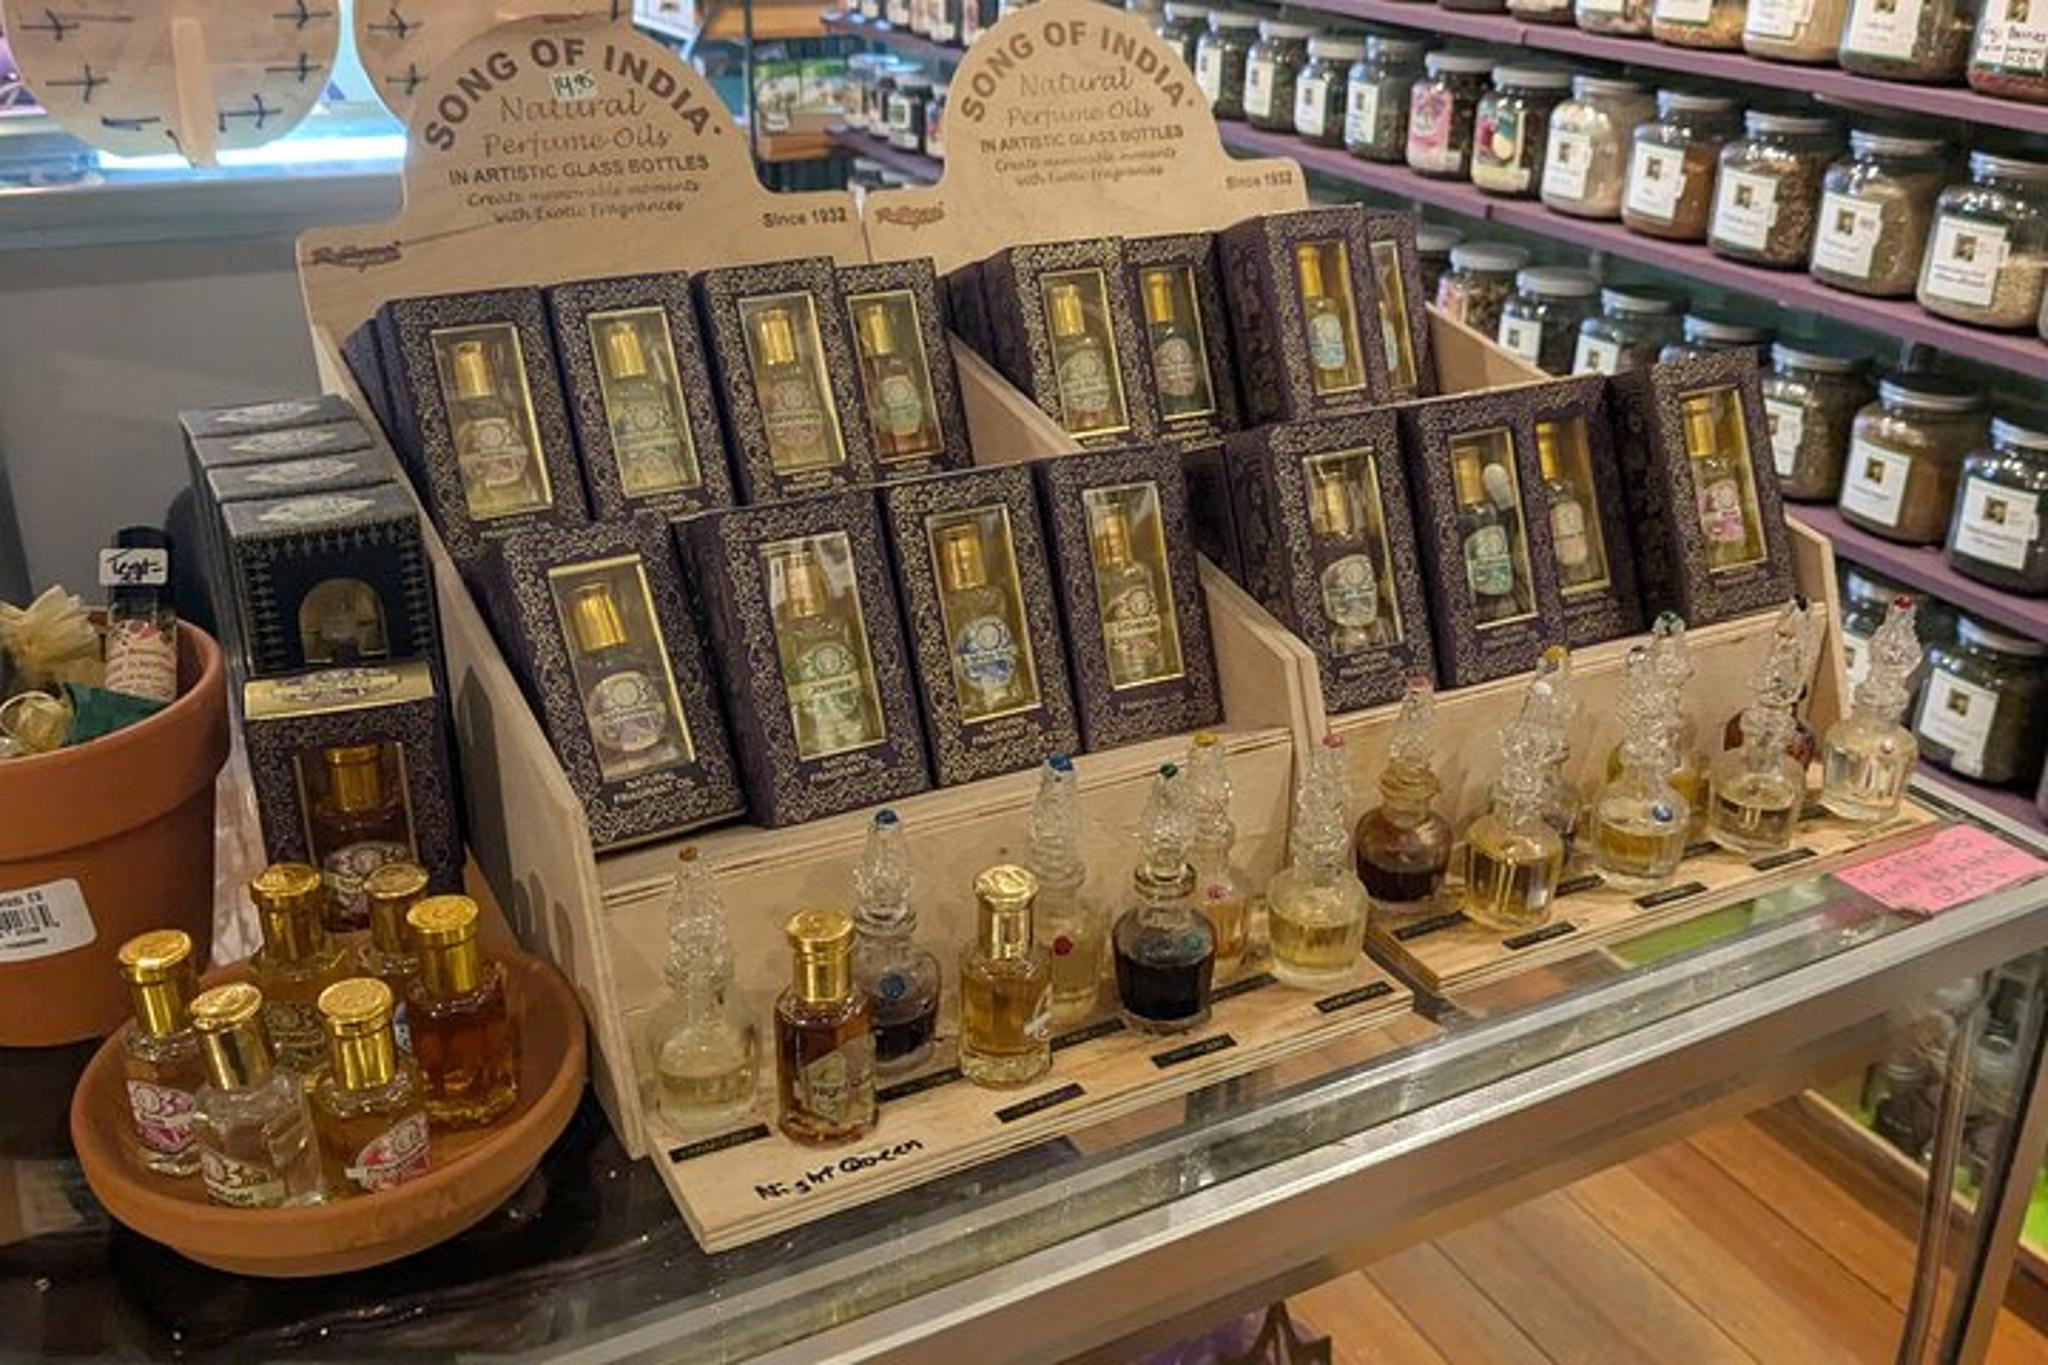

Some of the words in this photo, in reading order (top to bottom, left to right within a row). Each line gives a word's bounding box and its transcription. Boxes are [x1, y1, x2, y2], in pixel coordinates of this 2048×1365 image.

[961, 33, 1034, 122] SONG
[1043, 21, 1086, 47] OF
[1019, 66, 1134, 97] Natural
[425, 52, 518, 151] SONG
[530, 39, 585, 68] OF
[501, 89, 645, 122] Natural
[1007, 105, 1100, 129] Perfume
[1108, 97, 1151, 119] Oils
[482, 130, 603, 158] Perfume
[613, 124, 670, 149] Oils
[981, 139, 996, 153] IN
[1000, 134, 1066, 151] ARTISTIC
[1069, 131, 1117, 147] GLASS
[1120, 125, 1184, 141] BOTTLES
[450, 169, 468, 185] IN
[473, 164, 558, 184] ARTISTIC
[562, 159, 624, 178] GLASS
[628, 154, 709, 174] BOTTLES
[762, 211, 806, 228] Since
